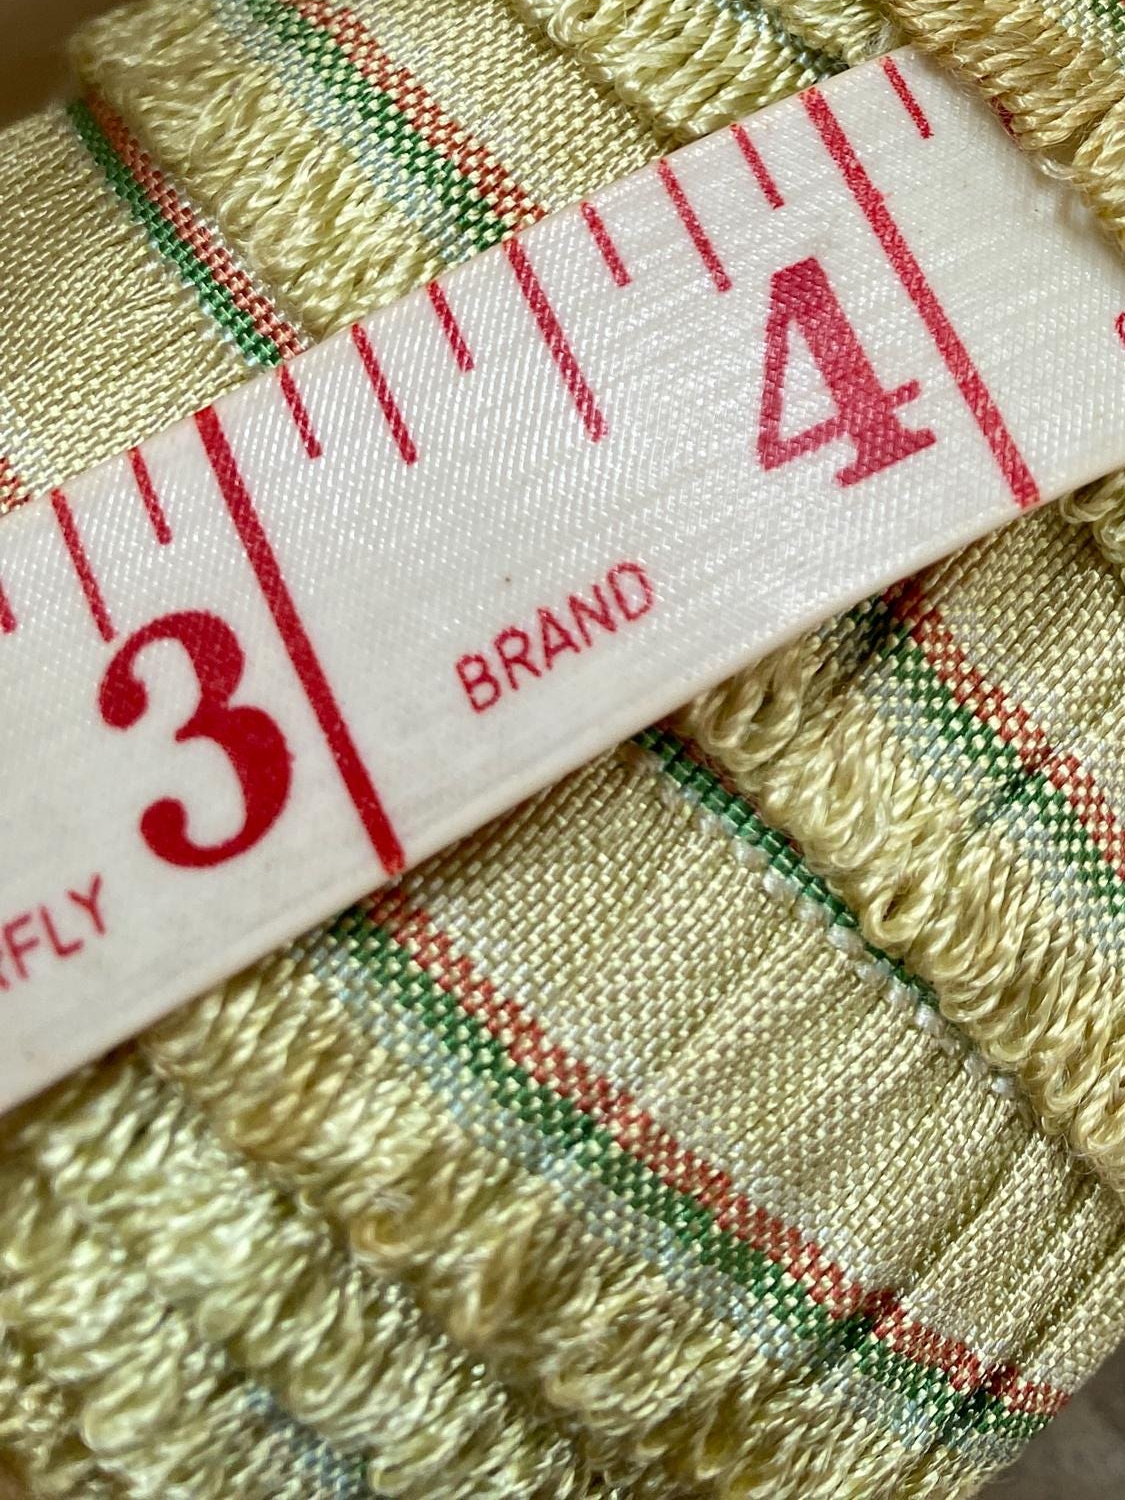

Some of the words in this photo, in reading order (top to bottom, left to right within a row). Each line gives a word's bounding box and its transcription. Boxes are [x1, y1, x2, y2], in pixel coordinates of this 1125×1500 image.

[756, 256, 937, 488] 4
[0, 873, 106, 992] FLY
[455, 562, 654, 713] BRAND
[98, 610, 293, 868] 3
